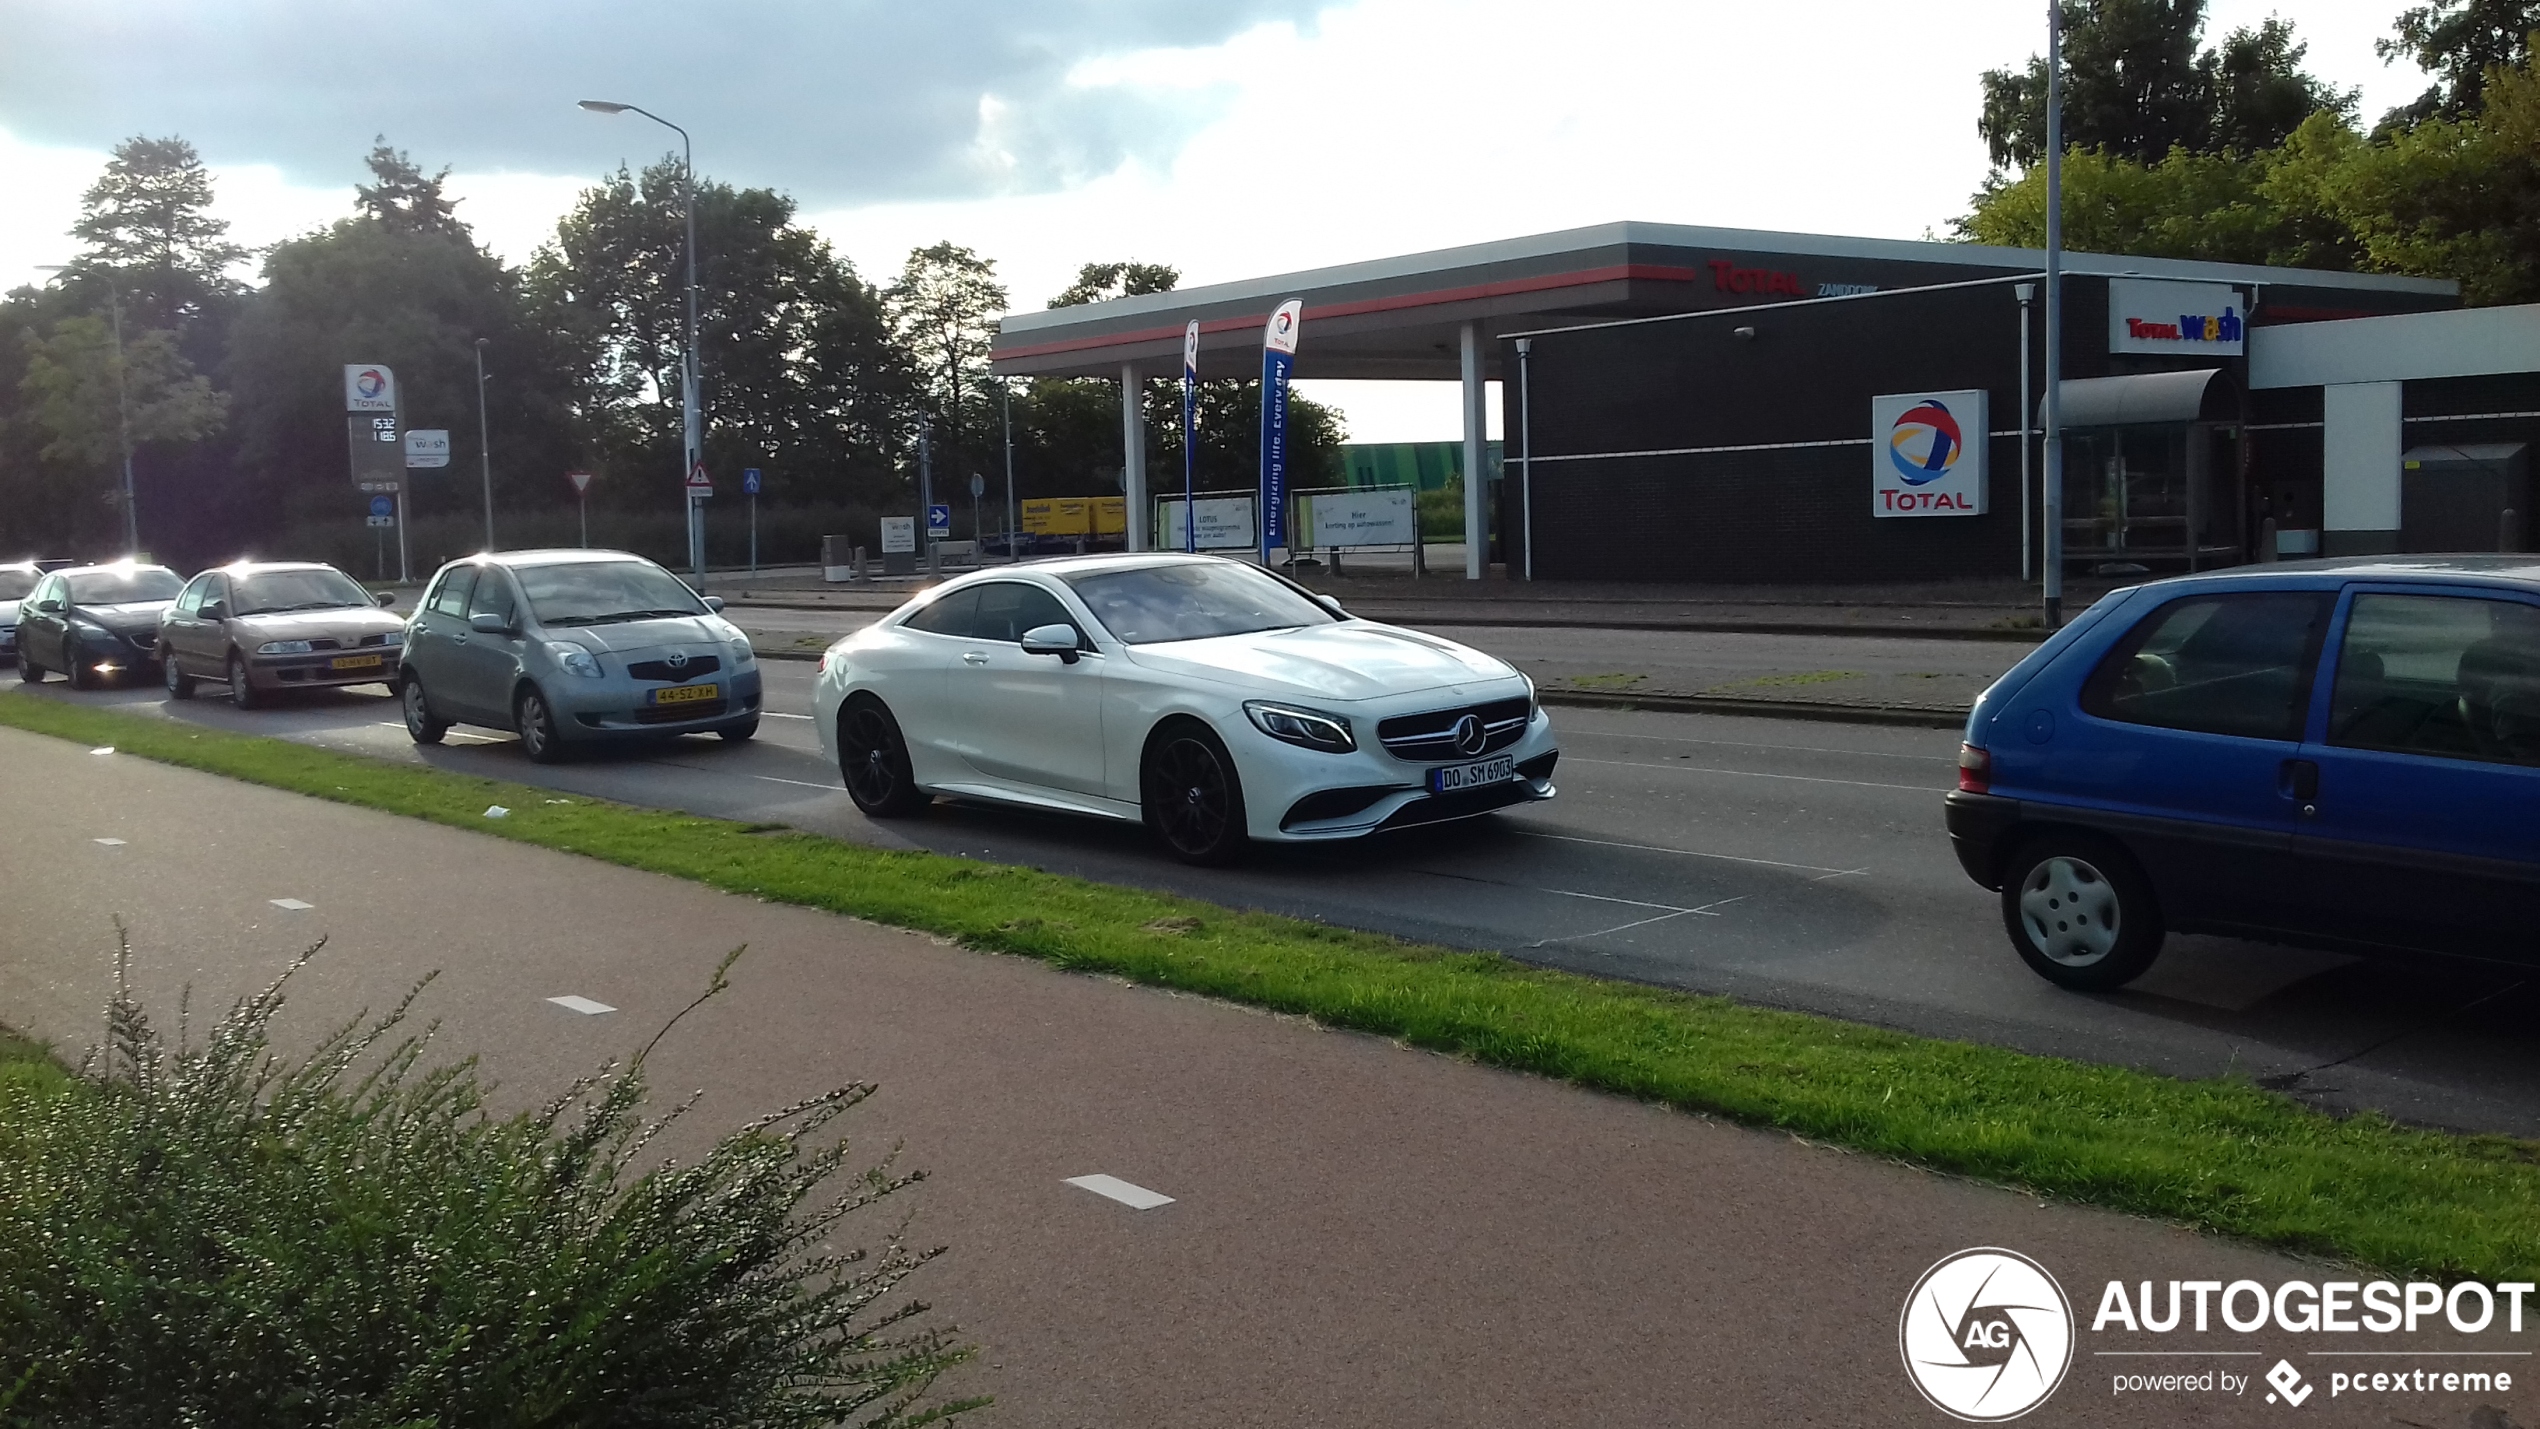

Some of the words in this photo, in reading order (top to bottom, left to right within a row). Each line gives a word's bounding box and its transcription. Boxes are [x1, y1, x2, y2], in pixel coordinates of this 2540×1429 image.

[1707, 260, 1806, 295] TOTAL
[2126, 317, 2182, 340] TOTAL
[1273, 337, 1290, 348] TOTAL
[353, 399, 392, 408] TOTAL
[1268, 463, 1283, 536] Energizing
[1879, 489, 1973, 512] TOTAL
[660, 686, 713, 701] 44-SZ-XH
[1443, 768, 1461, 788] DO
[1487, 759, 1511, 780] 6903
